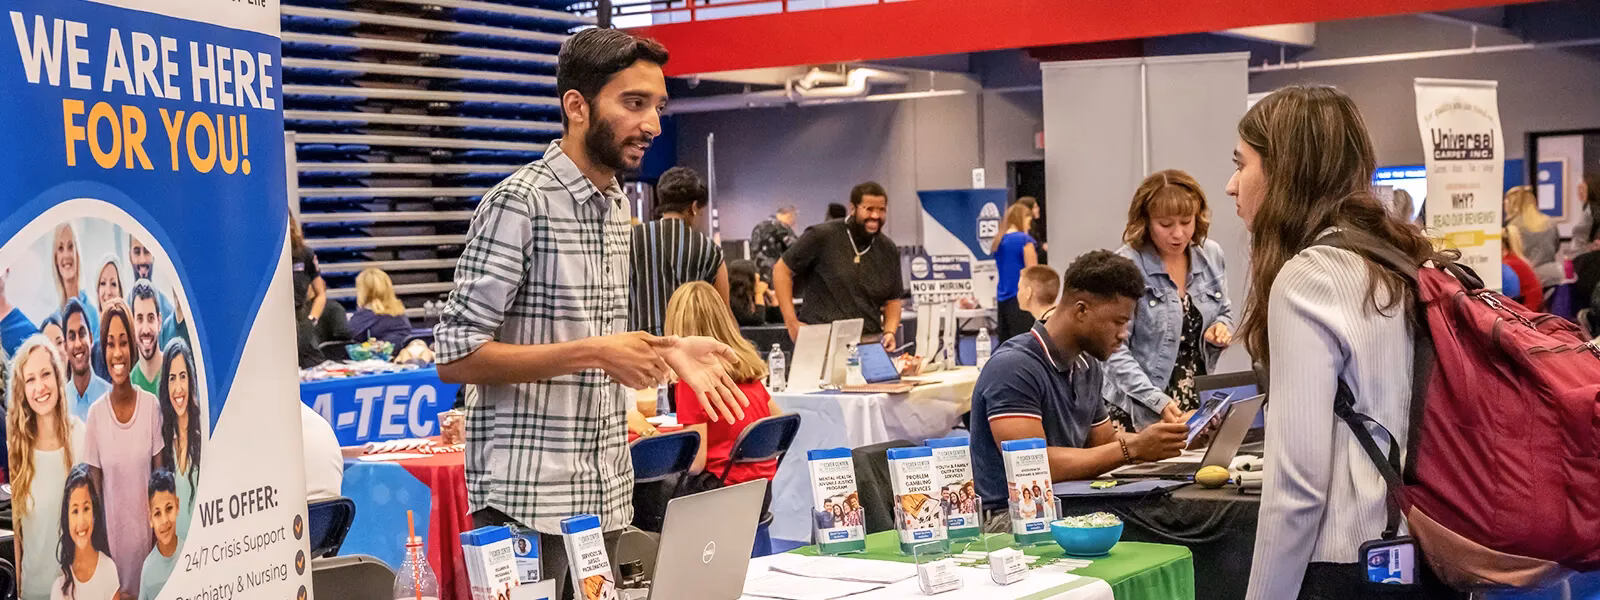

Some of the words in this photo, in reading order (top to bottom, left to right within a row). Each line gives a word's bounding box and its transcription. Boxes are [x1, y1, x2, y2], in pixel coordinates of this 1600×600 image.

[9, 11, 92, 90] WE
[103, 28, 181, 100] ARE
[190, 41, 275, 110] HERE
[62, 98, 154, 170] FOR
[159, 107, 251, 175] YOU!
[1431, 128, 1494, 149] Universal
[1435, 150, 1466, 159] CARPET
[1470, 150, 1492, 158] INC.
[1451, 193, 1474, 209] WHY?
[1433, 214, 1450, 227] READ
[913, 283, 935, 291] NOW
[940, 282, 972, 291] HIRING
[905, 479, 931, 487] GAMBLING
[199, 498, 225, 528] WE
[228, 485, 278, 520] OFFER:
[185, 546, 208, 572] 24/7
[212, 538, 242, 562] Crisis
[243, 526, 286, 552] Support
[176, 583, 235, 600] chiatry
[237, 575, 244, 592] &
[246, 564, 288, 588] Nursing
